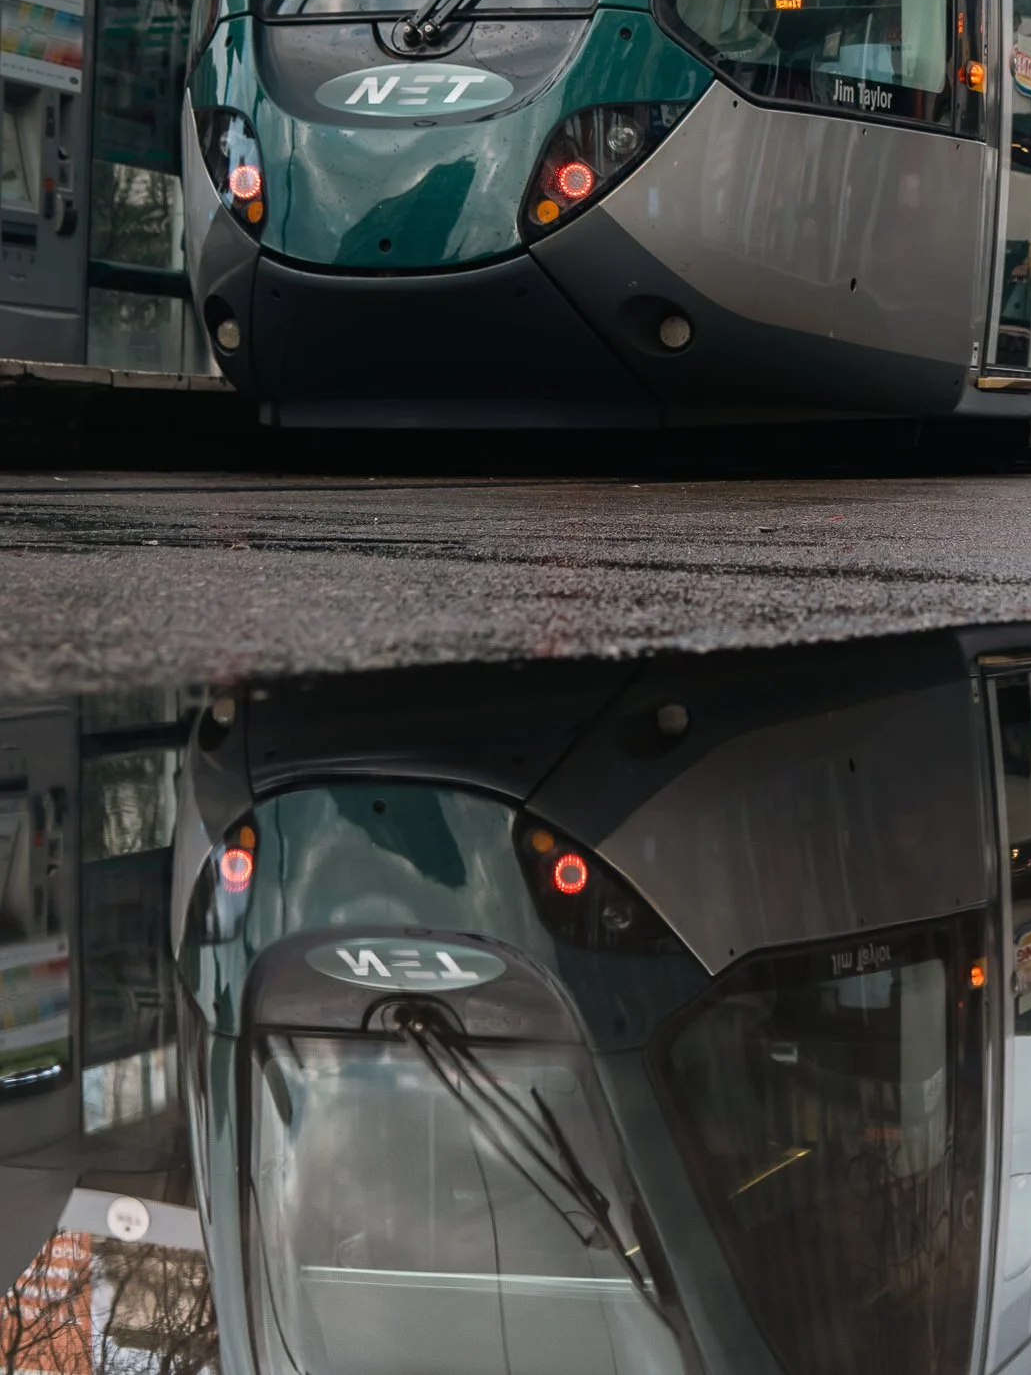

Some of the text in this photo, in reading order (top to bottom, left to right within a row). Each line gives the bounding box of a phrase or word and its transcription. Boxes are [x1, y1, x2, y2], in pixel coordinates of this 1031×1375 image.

[344, 75, 488, 105] NET
[833, 79, 893, 111] Jim Taylor
